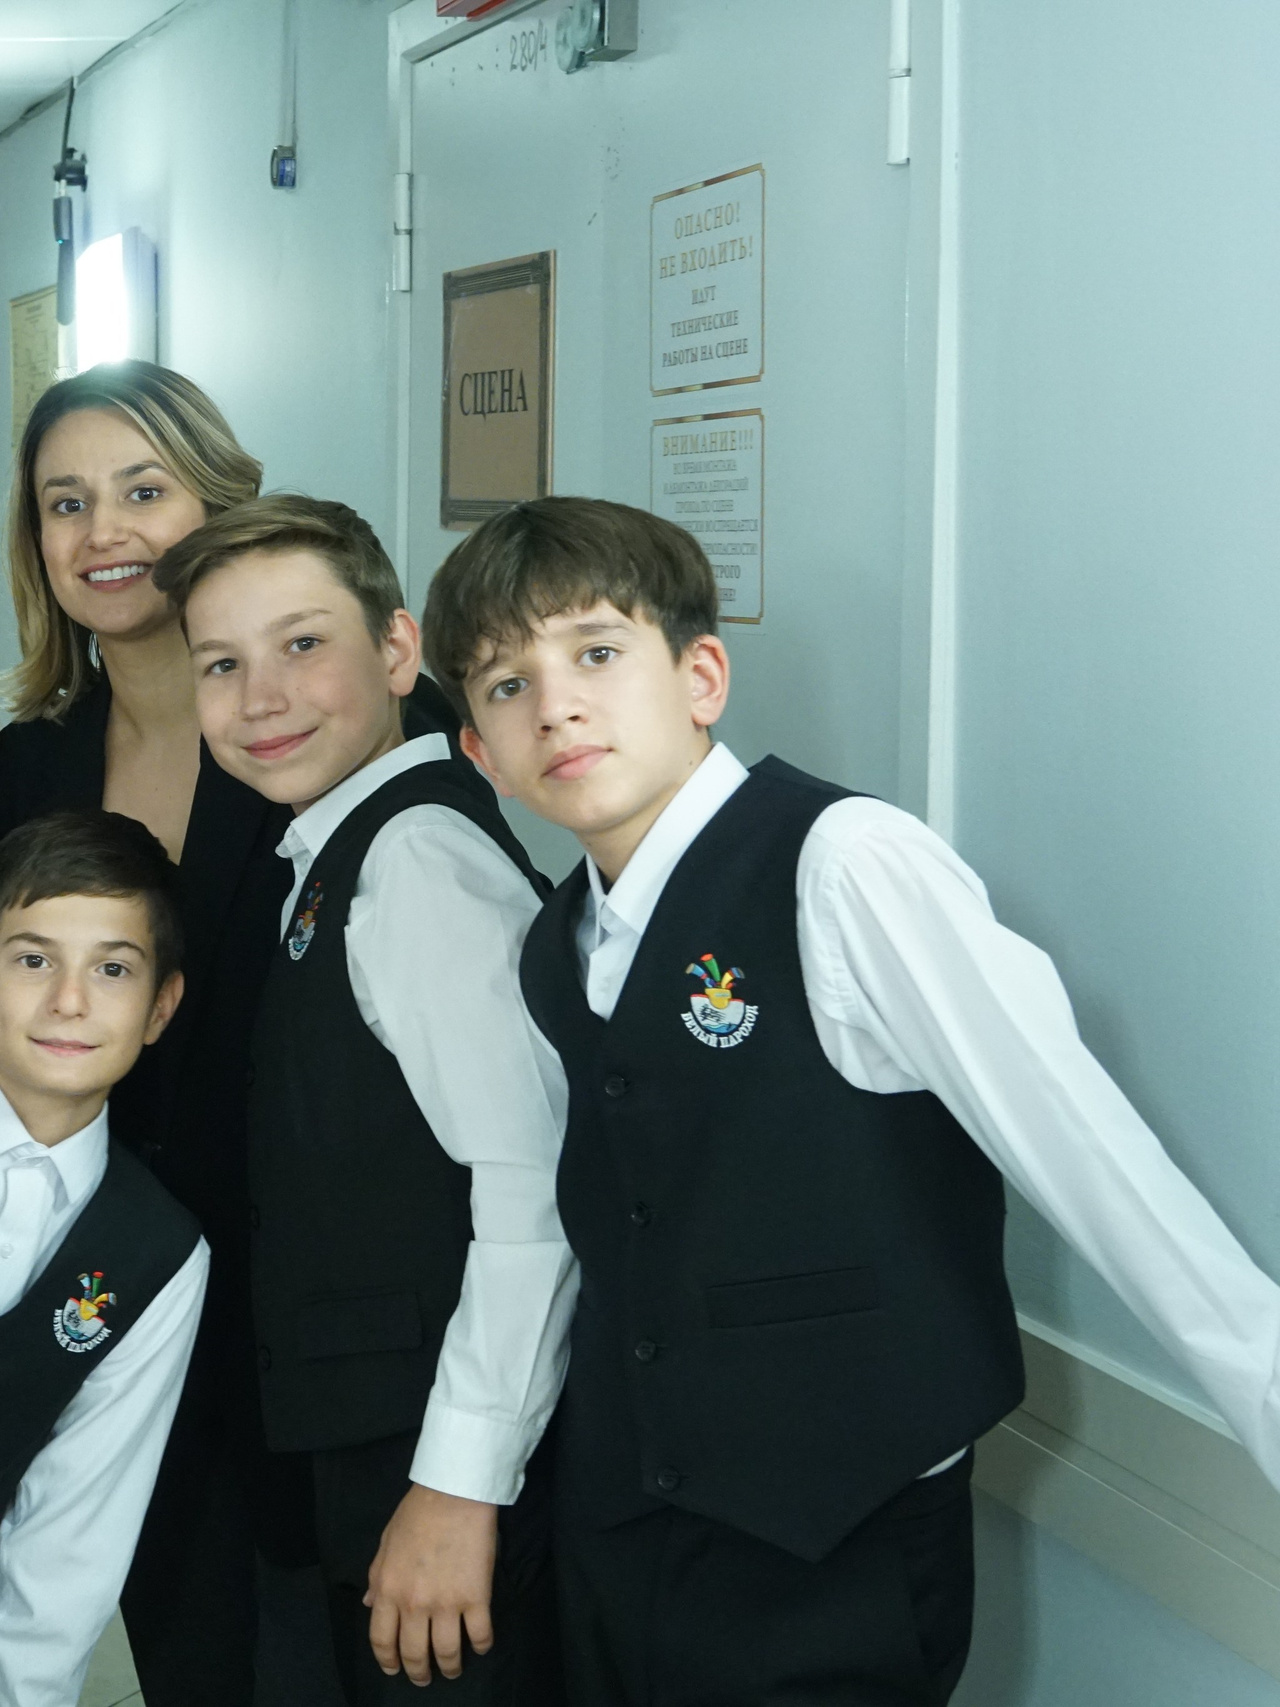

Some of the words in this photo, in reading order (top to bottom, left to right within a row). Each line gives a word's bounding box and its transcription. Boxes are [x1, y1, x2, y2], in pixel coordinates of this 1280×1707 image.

[674, 201, 740, 240] ОПАСНО!
[659, 255, 676, 280] НЕ
[680, 235, 753, 274] ВХОДИТЬ!
[691, 285, 716, 306] ИДУТ
[670, 309, 739, 338] ТЕХНИЧЕСКИЕ
[662, 346, 699, 368] РАБОТЫ
[700, 344, 714, 361] НА
[715, 337, 748, 360] СЦЕНЕ
[459, 367, 529, 421] СЦЕНА
[663, 428, 753, 457] ВНИМАНИЕ!!!
[680, 1011, 718, 1048] БЕЛЫЙ
[719, 1004, 760, 1048] ПАРОХОД
